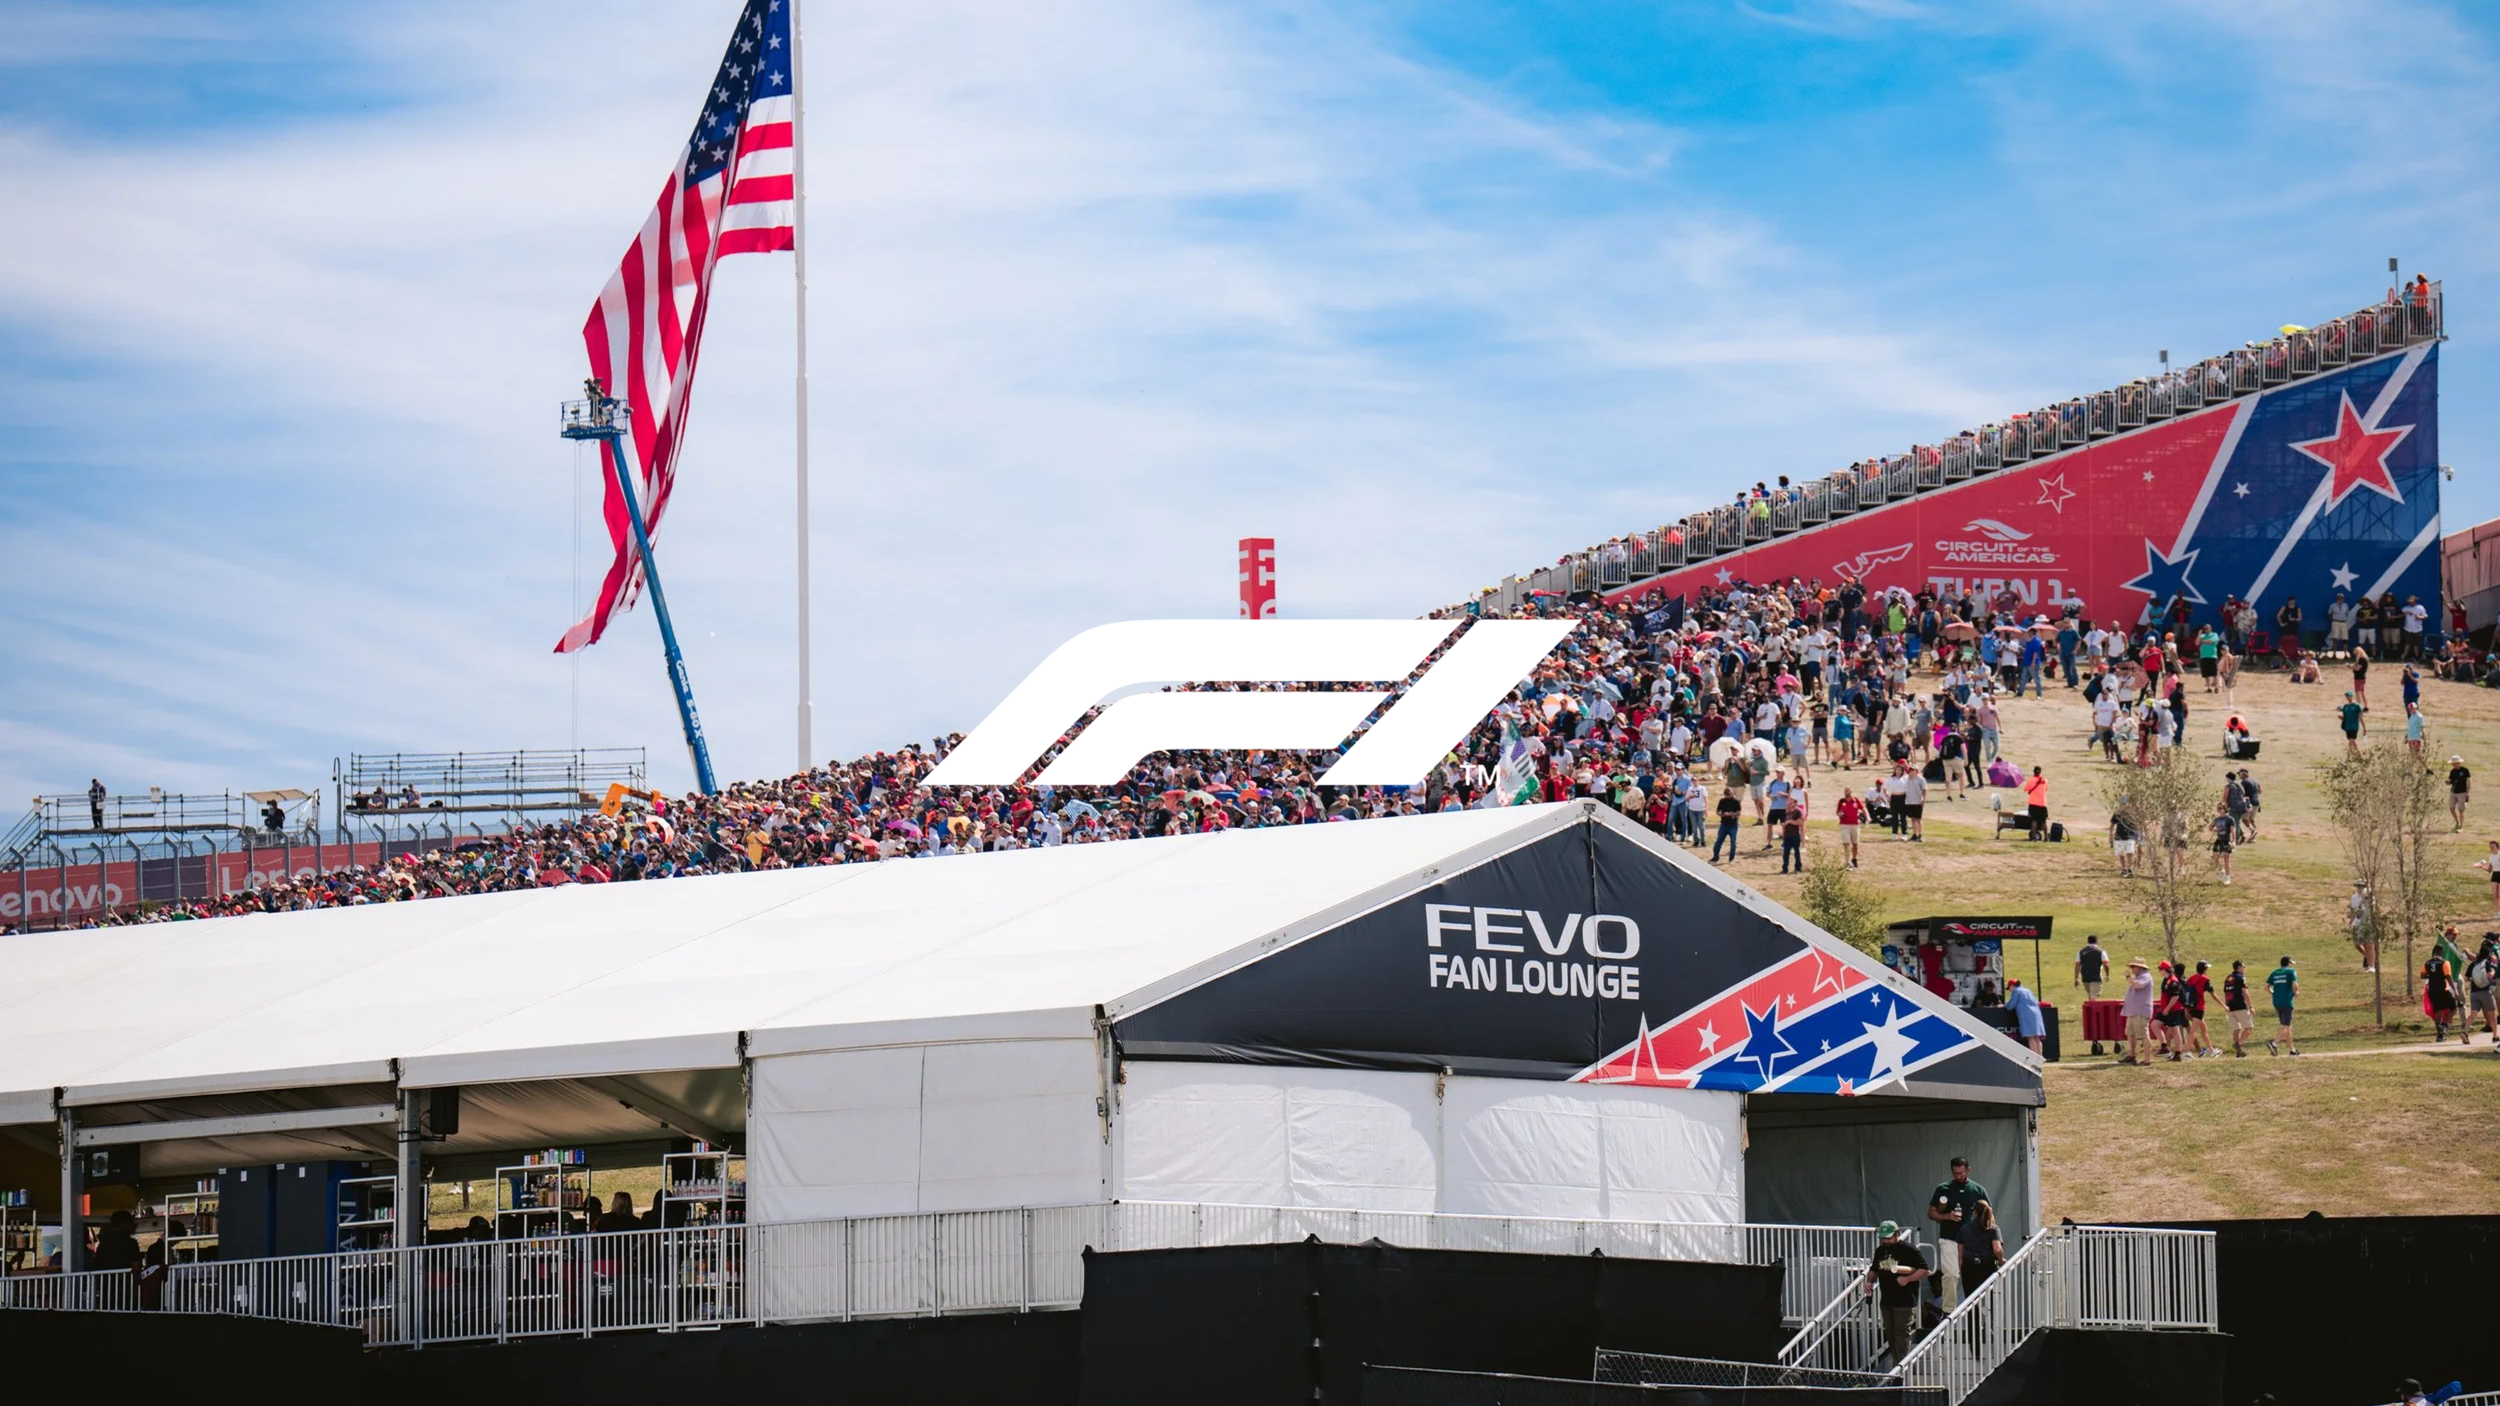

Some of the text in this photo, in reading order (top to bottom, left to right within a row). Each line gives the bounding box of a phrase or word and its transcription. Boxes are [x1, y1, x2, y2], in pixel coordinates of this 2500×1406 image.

[1935, 541, 2018, 553] CIRCUIT
[1945, 552, 2055, 563] AMERICAS
[2048, 578, 2063, 605] 1
[1425, 903, 1640, 960] FEVO
[1429, 954, 1640, 1000] FAN LOUNGE
